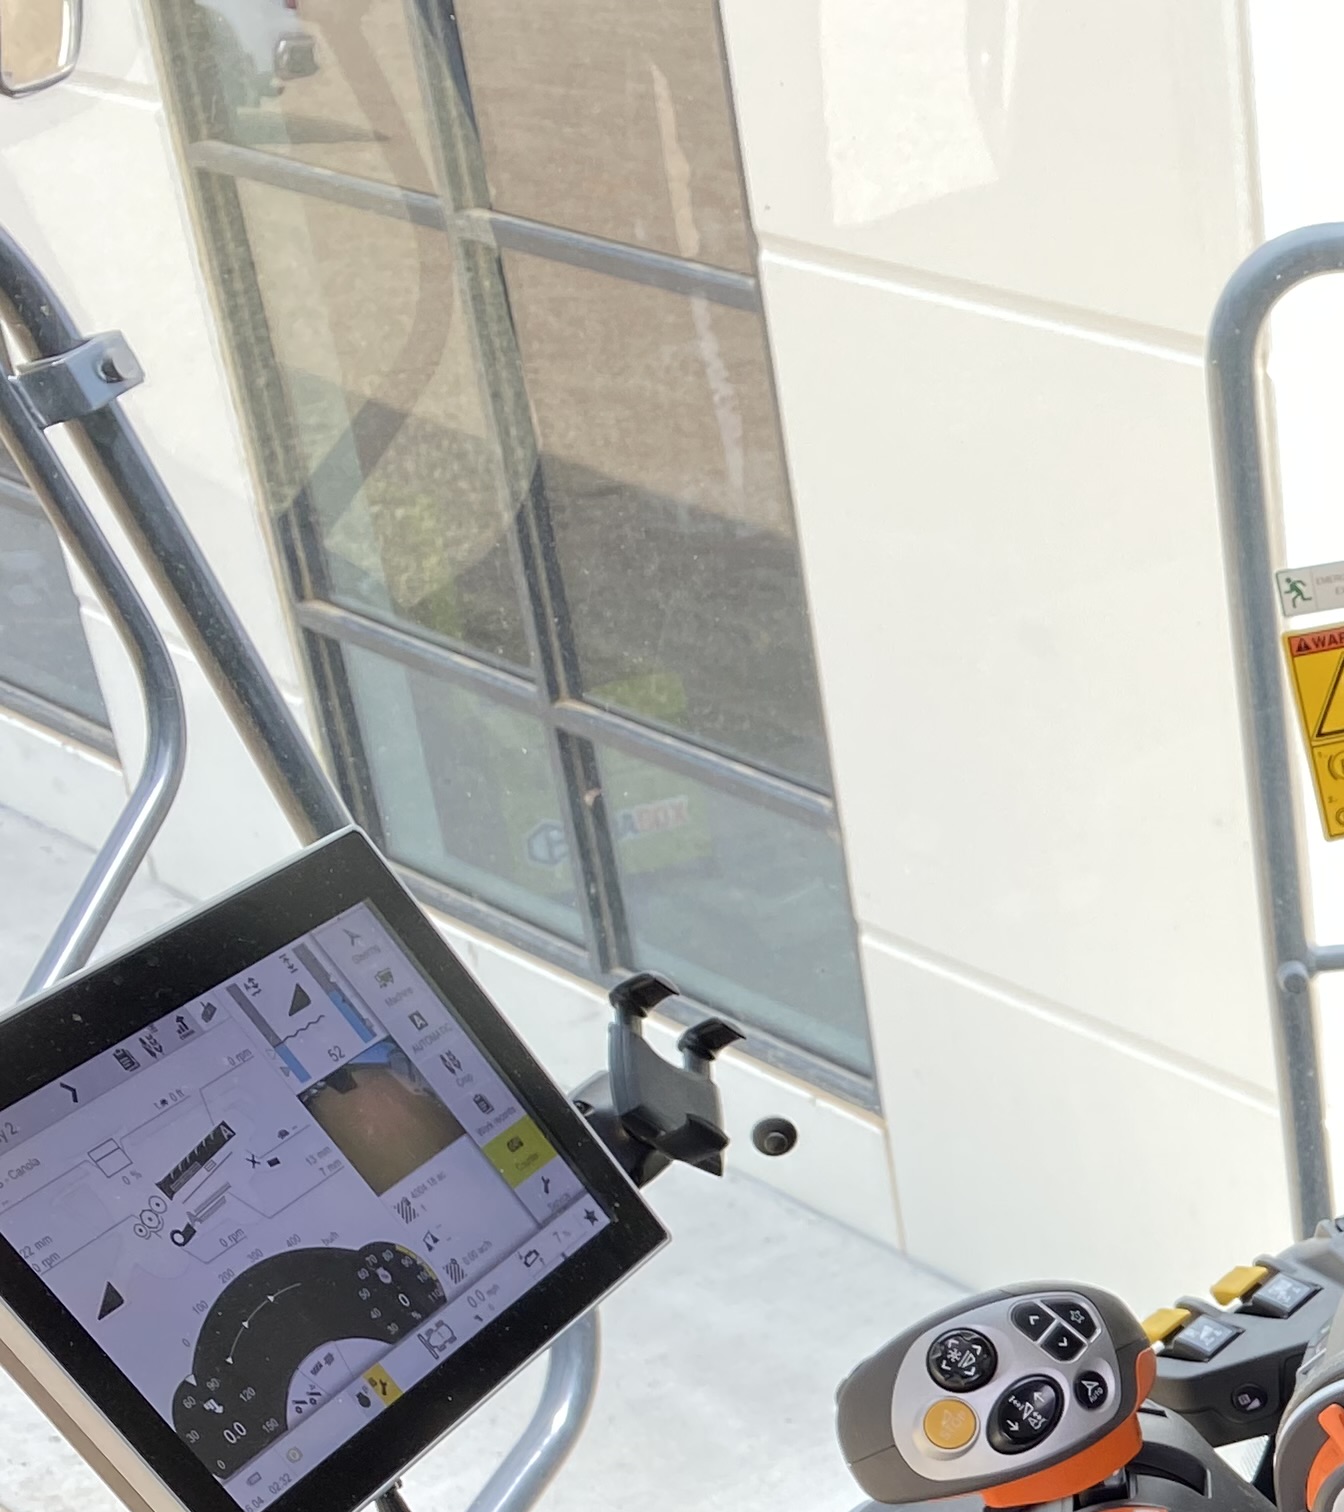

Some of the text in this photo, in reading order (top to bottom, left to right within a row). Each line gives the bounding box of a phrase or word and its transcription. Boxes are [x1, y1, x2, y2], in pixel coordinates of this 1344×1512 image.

[411, 1022, 453, 1055] AUTOMATIC
[236, 1048, 253, 1064] rpm
[327, 1045, 346, 1063] 52
[8, 1157, 41, 1180] Canola
[326, 1158, 343, 1173] mm
[34, 1235, 53, 1251] mm
[217, 1226, 247, 1249] 0 rpm
[285, 1232, 302, 1249] 400
[40, 1251, 62, 1271] rpm
[247, 1247, 264, 1264] 300
[364, 1253, 379, 1267] 70
[217, 1267, 236, 1285] 200
[358, 1287, 372, 1303] 50
[397, 1293, 412, 1308] 0
[191, 1299, 210, 1316] 100
[369, 1306, 384, 1322] 40
[387, 1321, 401, 1337] 30
[206, 1377, 222, 1393] 90
[181, 1394, 197, 1410] 60
[238, 1385, 258, 1404] 120
[1089, 1386, 1104, 1404] AUTO
[222, 1420, 249, 1446] 0.0
[261, 1416, 281, 1435] 150
[185, 1428, 201, 1445] 30
[216, 1458, 227, 1471] 0
